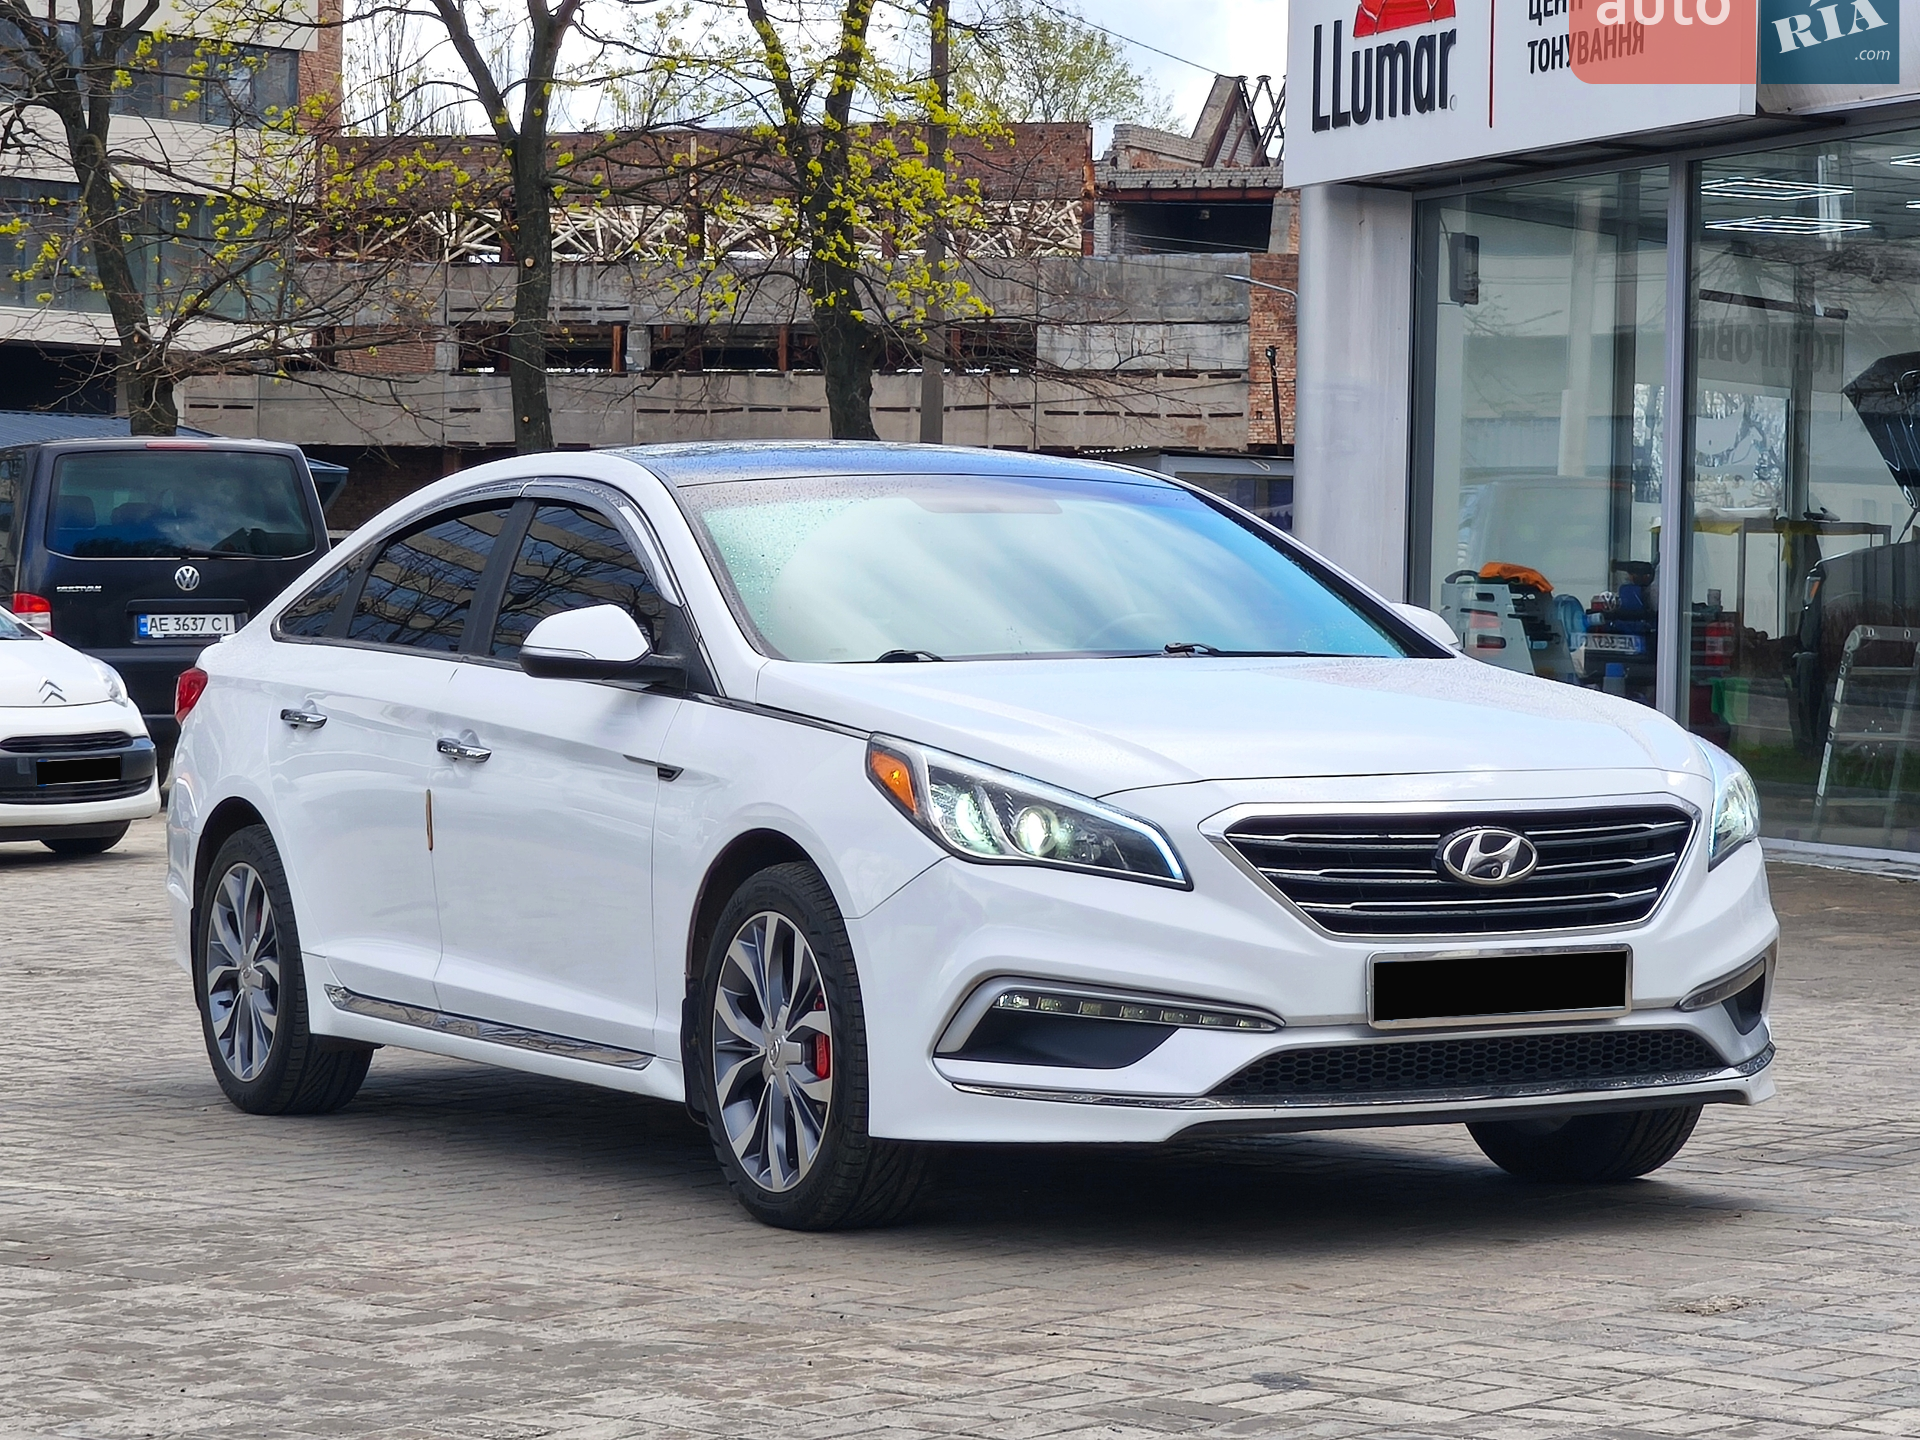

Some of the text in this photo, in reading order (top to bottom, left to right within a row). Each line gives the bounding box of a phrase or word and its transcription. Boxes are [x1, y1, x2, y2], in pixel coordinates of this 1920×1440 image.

[1528, 0, 1583, 26] ЦЕН
[1527, 18, 1645, 75] ТОНУВАННЯ
[1312, 20, 1457, 133] LLumar
[149, 617, 170, 632] AE
[173, 617, 206, 632] 3637
